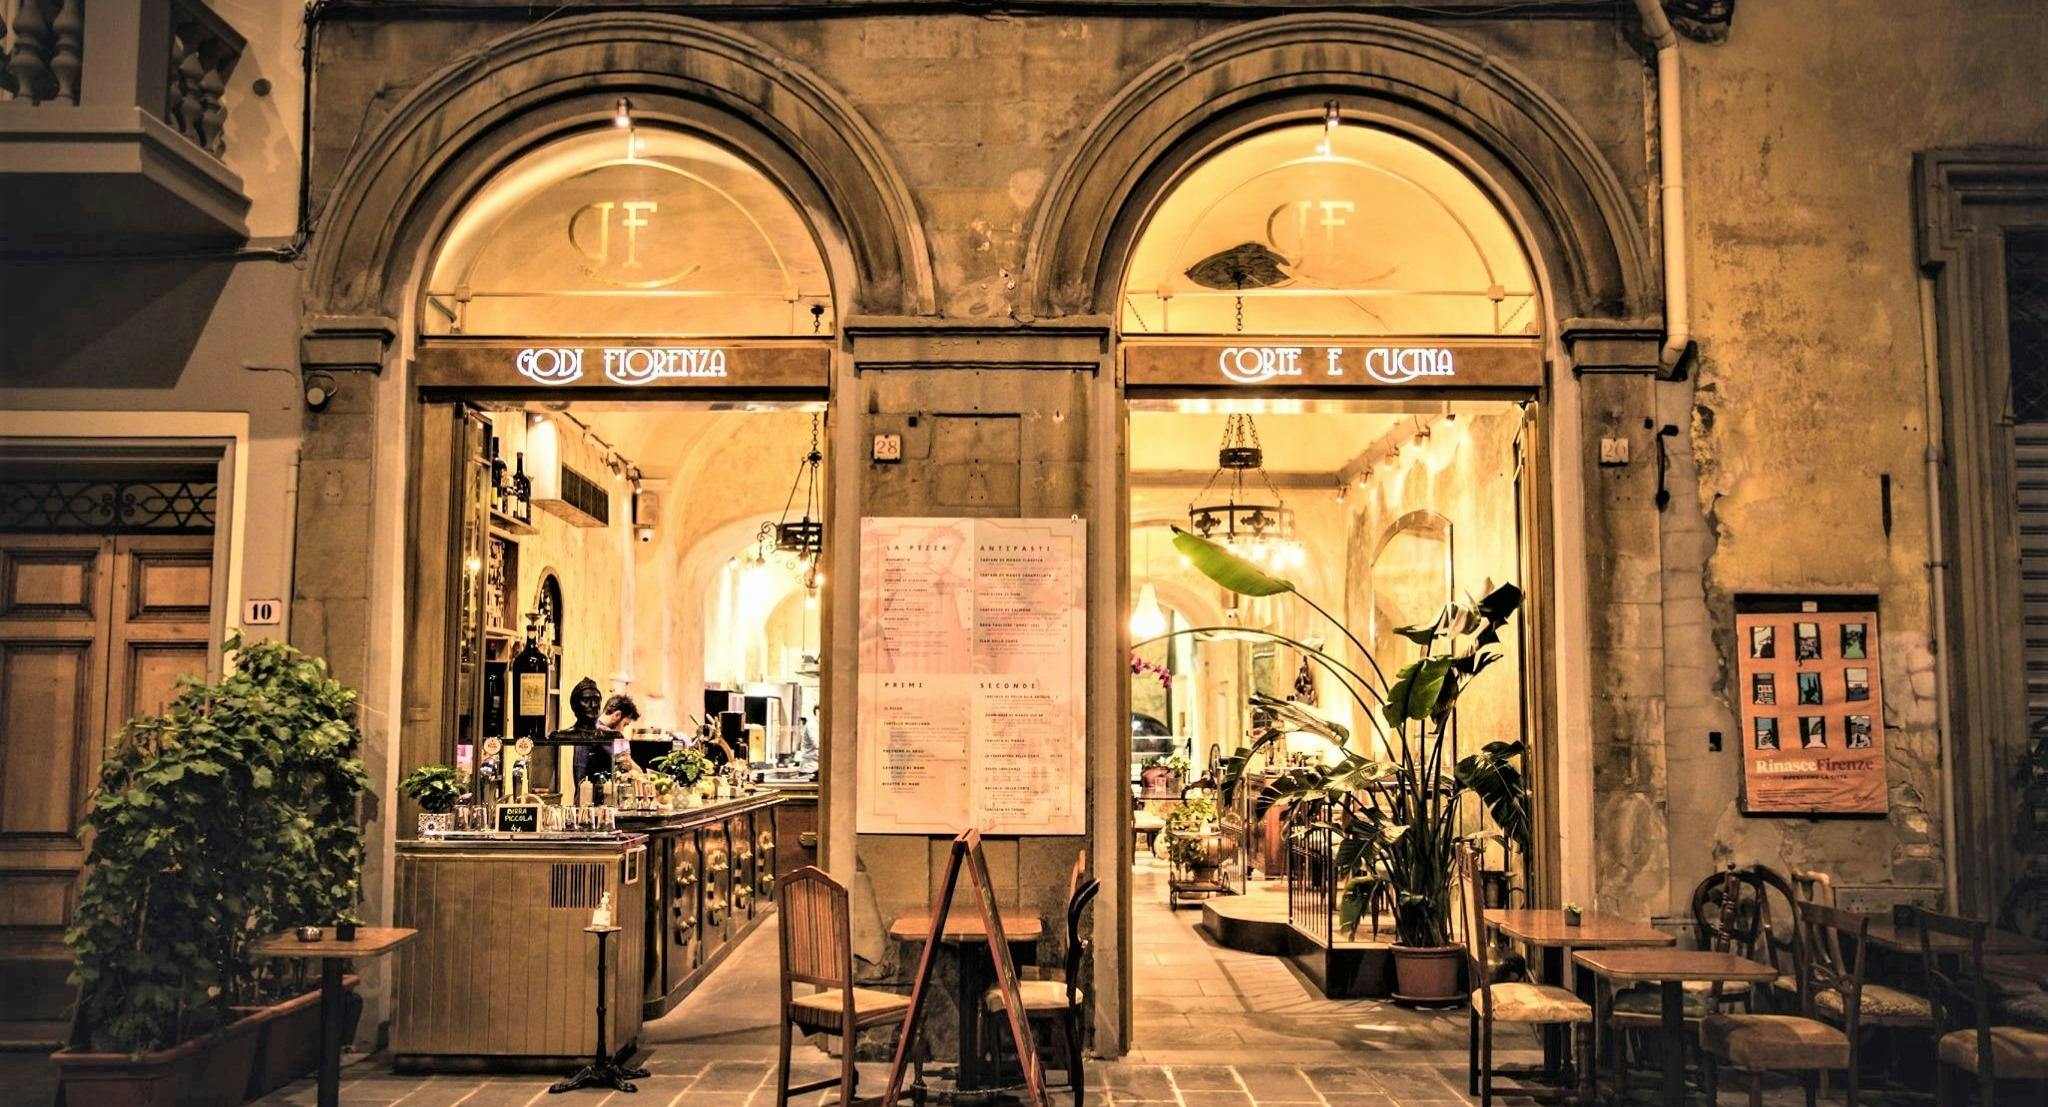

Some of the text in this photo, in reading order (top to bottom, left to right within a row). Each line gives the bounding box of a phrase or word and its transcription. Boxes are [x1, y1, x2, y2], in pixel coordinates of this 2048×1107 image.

[516, 348, 728, 385] GODI FIORENZA
[1219, 347, 1455, 383] CORTE E CUCINA
[876, 440, 897, 454] 28
[253, 604, 272, 620] 10
